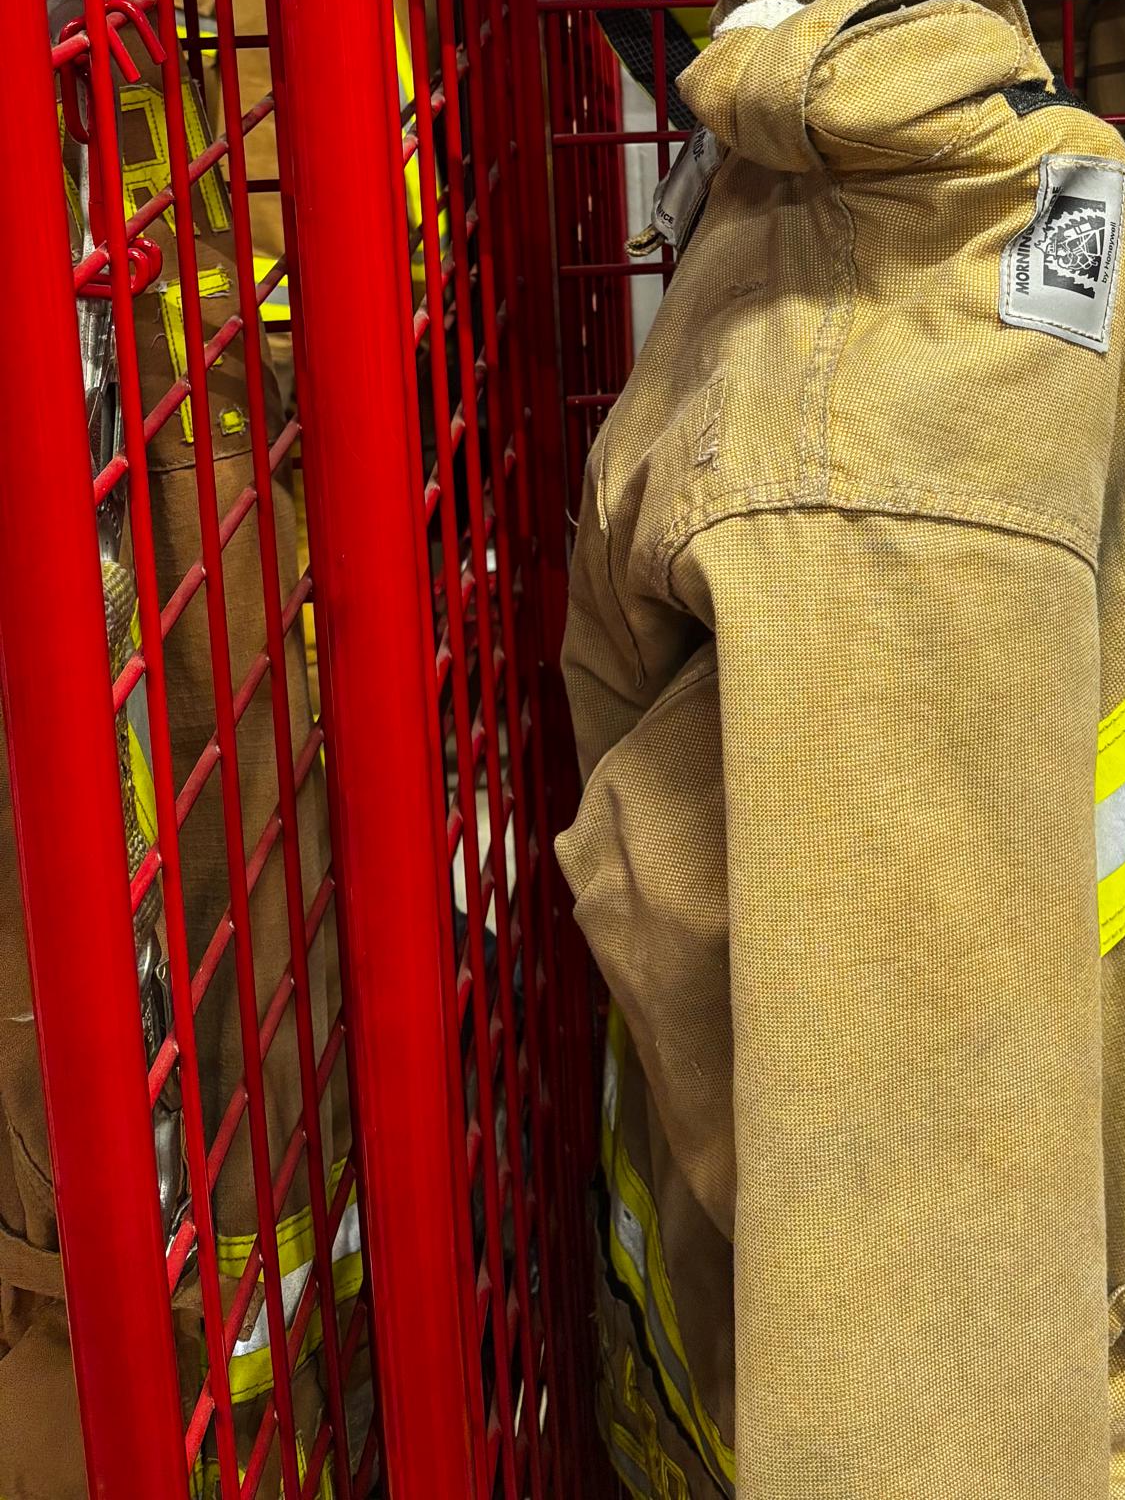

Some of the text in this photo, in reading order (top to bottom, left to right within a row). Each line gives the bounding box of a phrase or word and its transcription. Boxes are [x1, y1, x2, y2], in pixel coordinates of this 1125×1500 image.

[1015, 225, 1036, 295] MORNING
[1102, 221, 1117, 284] by Honeywell
